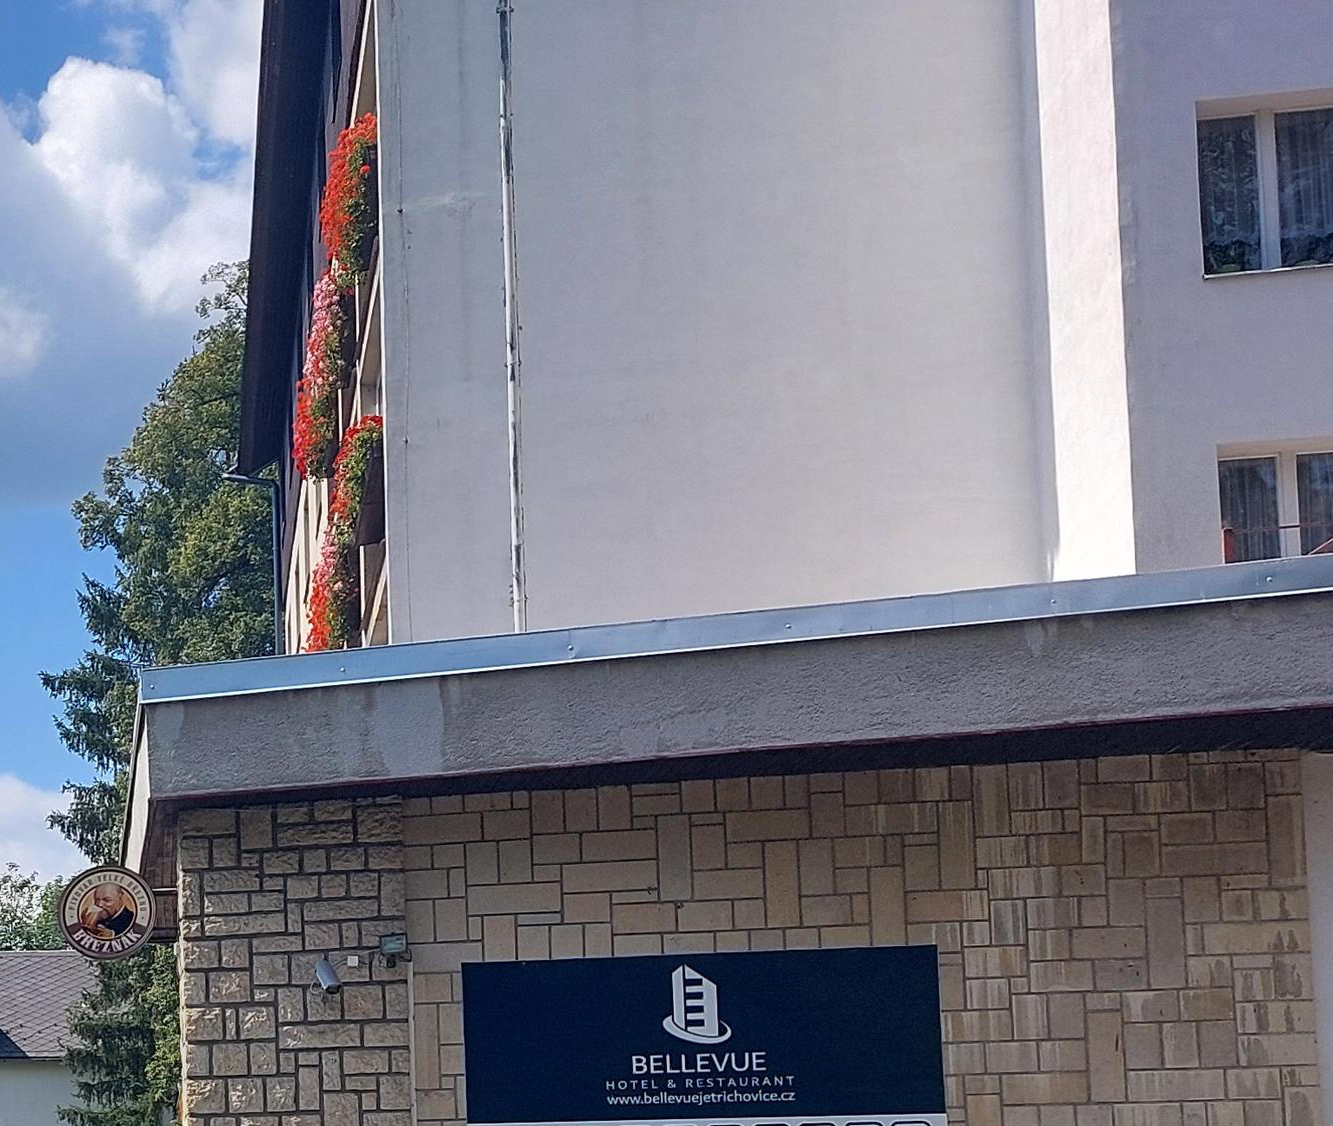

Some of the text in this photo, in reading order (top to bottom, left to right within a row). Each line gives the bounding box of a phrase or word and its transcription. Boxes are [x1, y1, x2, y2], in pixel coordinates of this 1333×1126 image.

[632, 1052, 767, 1074] BELLEVUE
[606, 1075, 795, 1091] HOTEL & RESTAURANT
[606, 1089, 796, 1105] www.bellevuejetrichovice.cz
